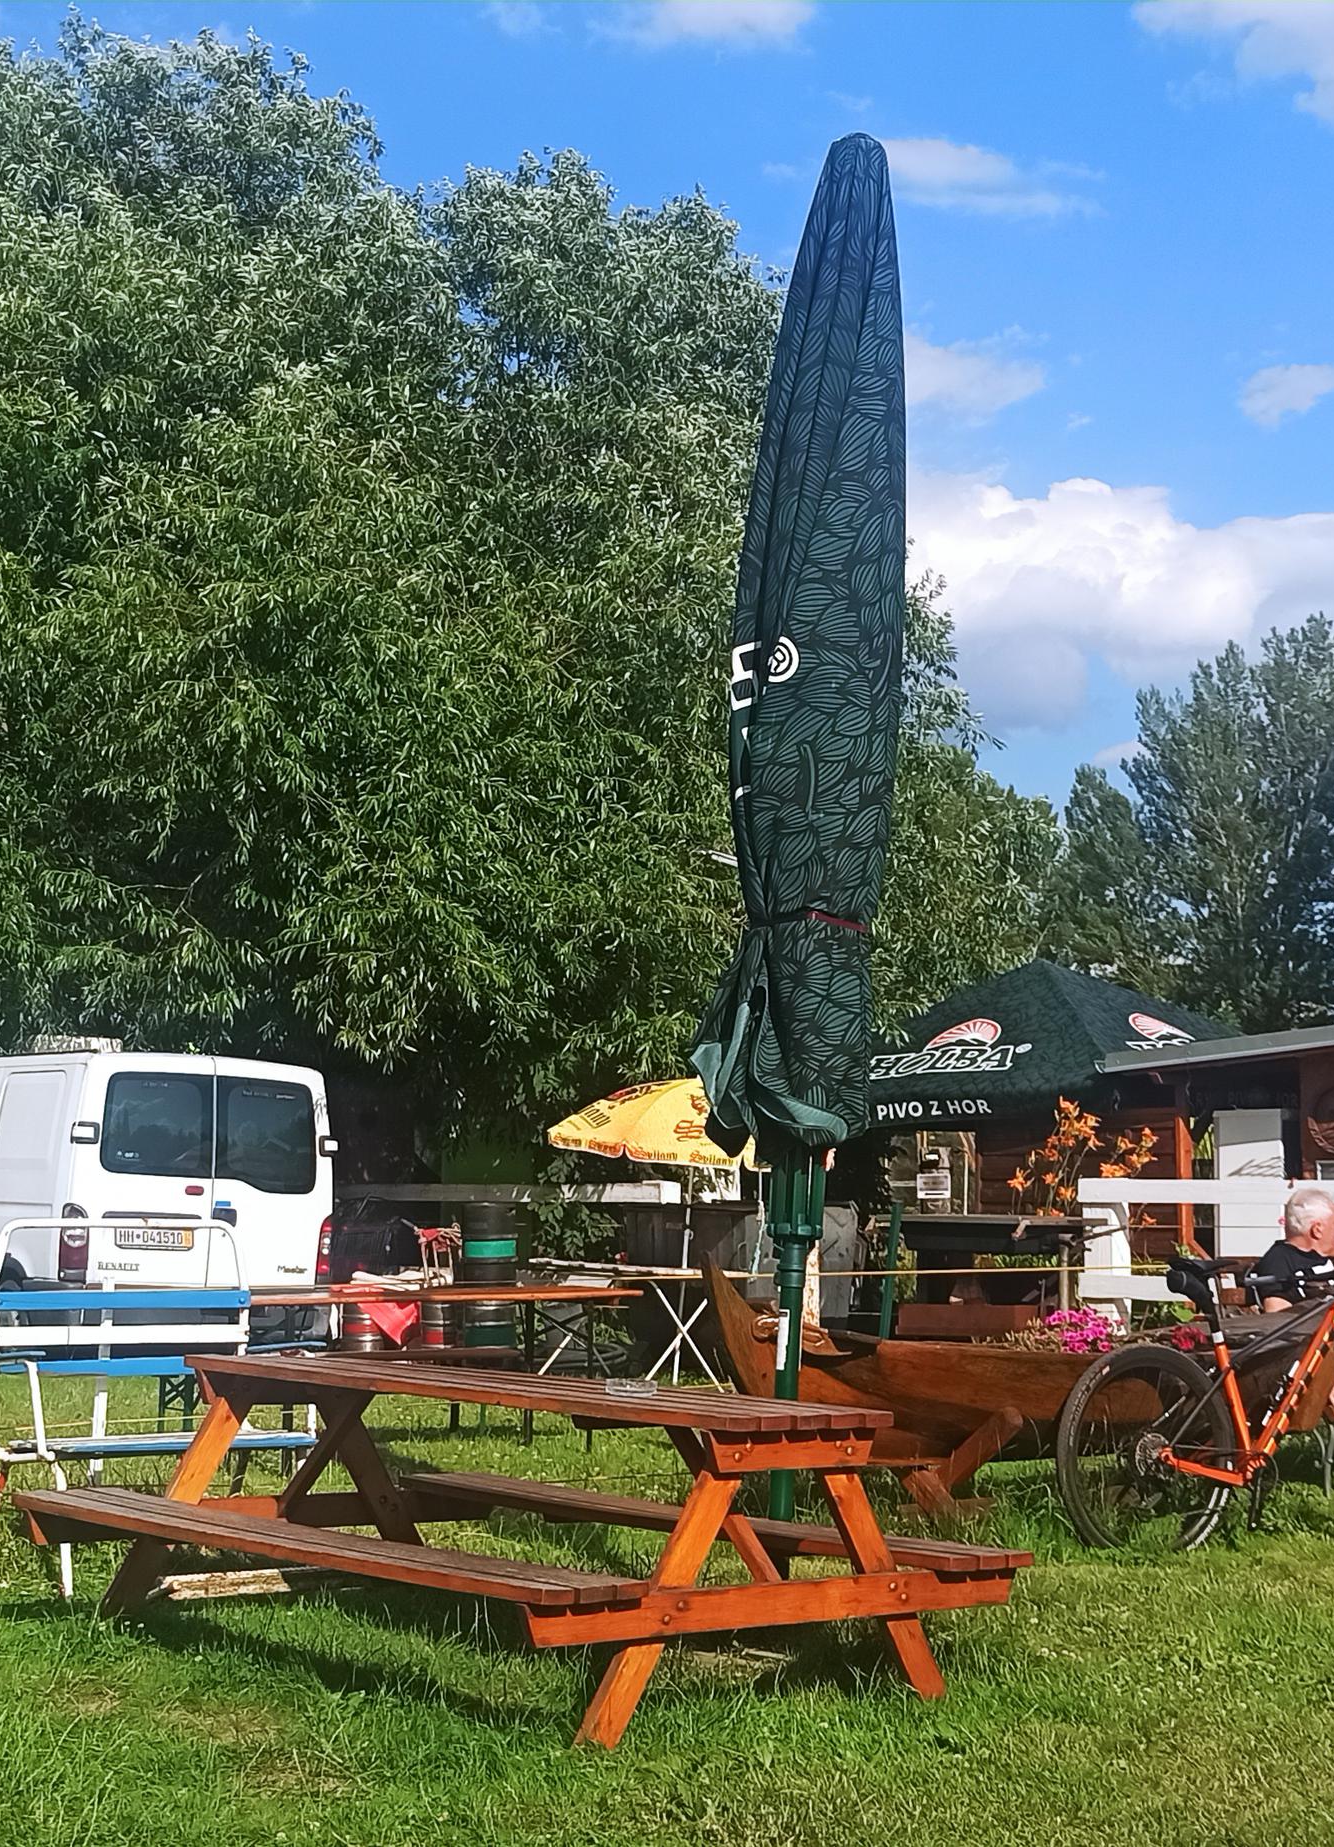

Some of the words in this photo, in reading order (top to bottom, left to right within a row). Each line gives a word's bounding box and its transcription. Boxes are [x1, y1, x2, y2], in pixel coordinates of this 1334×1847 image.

[869, 1045, 1014, 1080] HOLBA
[876, 1101, 923, 1120] PIVO
[929, 1101, 942, 1116] Z
[947, 1099, 992, 1114] HOR
[118, 1230, 135, 1243] HH
